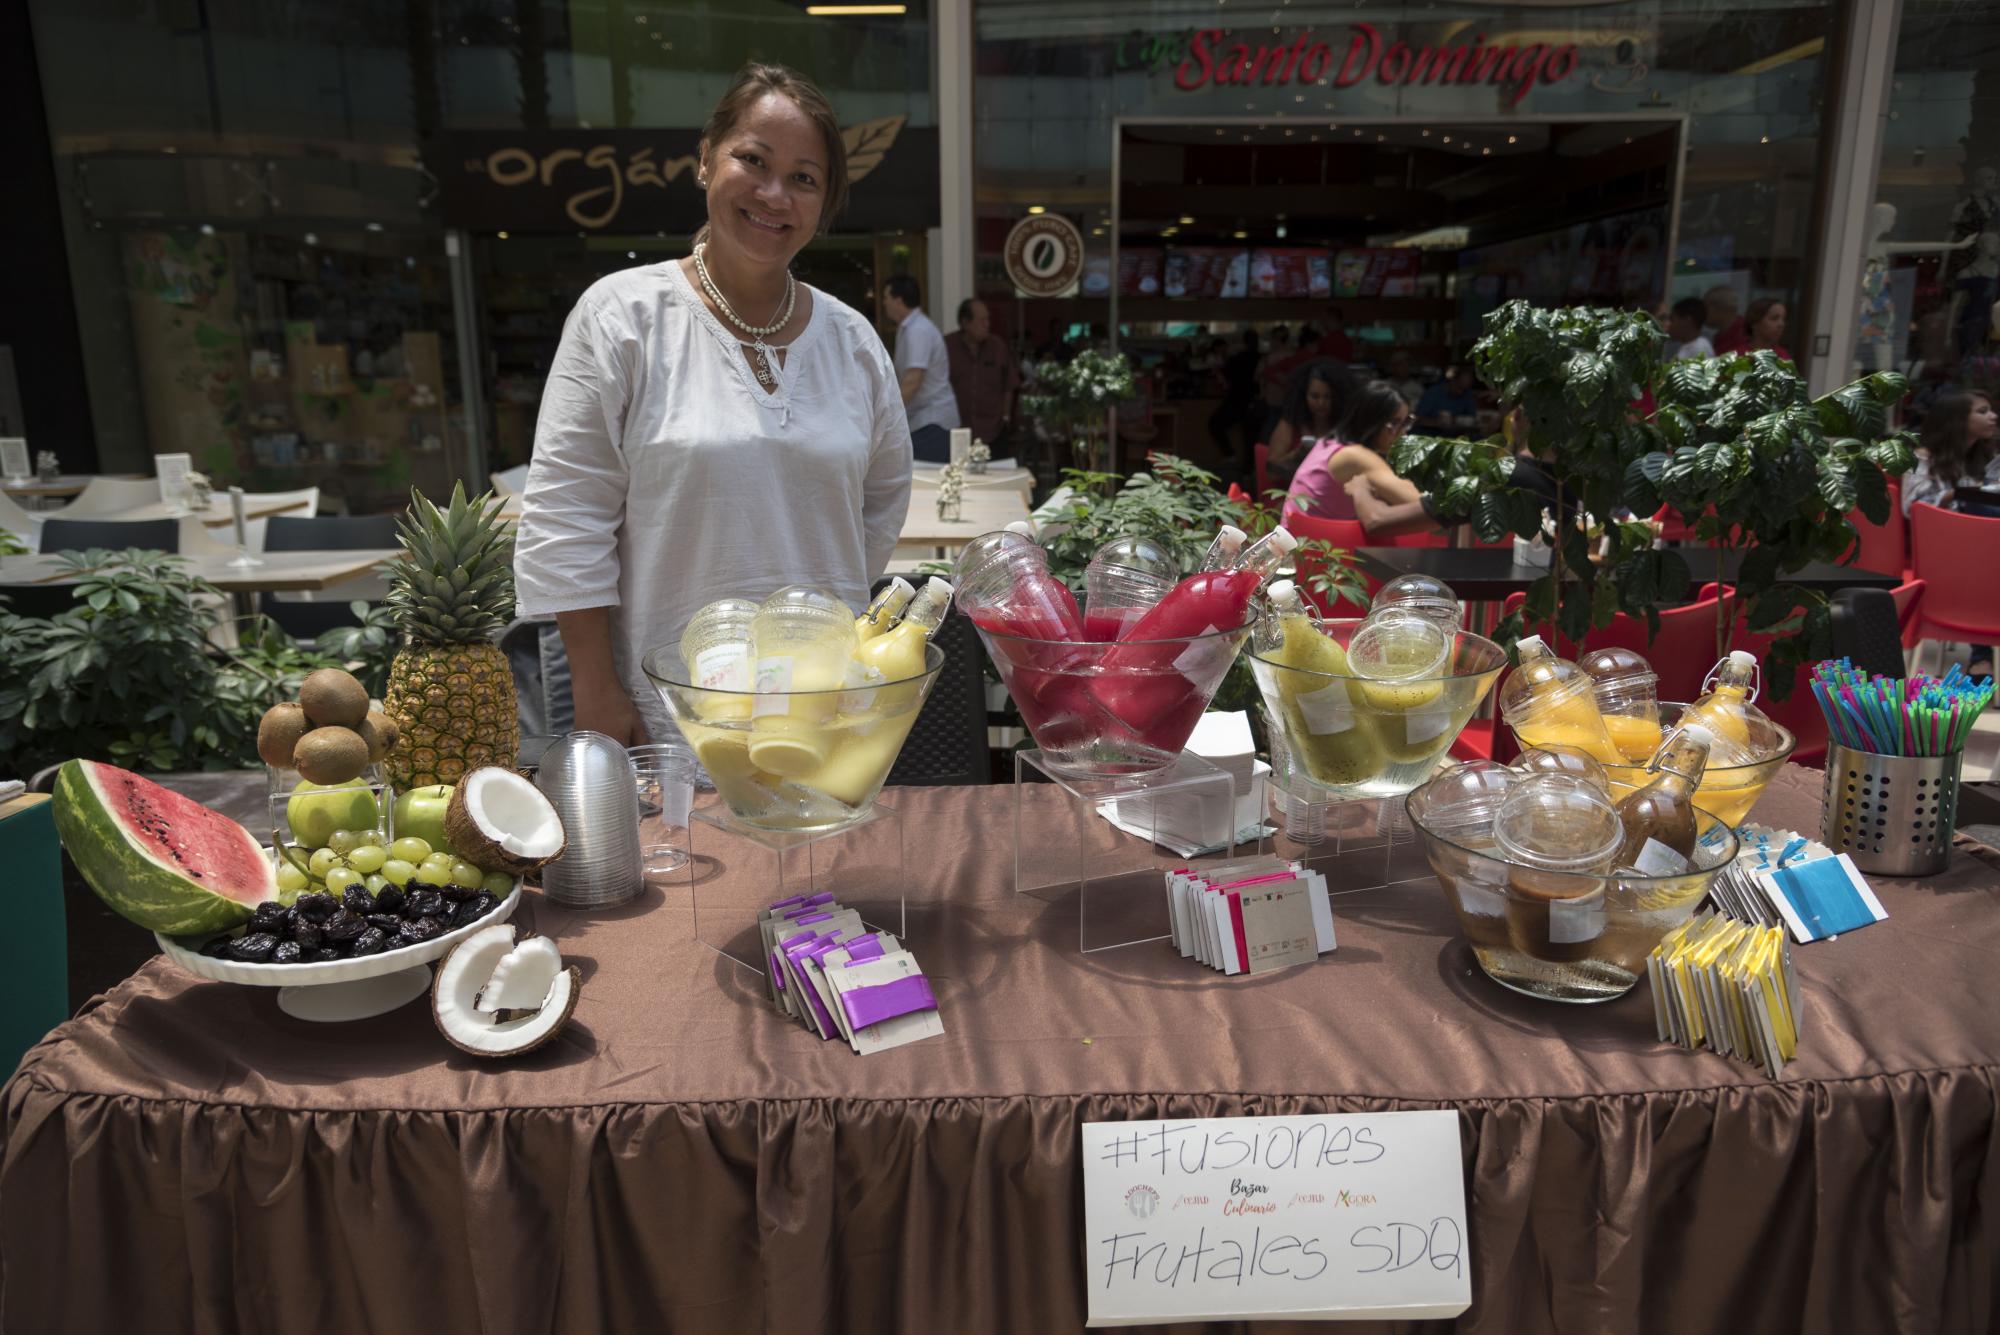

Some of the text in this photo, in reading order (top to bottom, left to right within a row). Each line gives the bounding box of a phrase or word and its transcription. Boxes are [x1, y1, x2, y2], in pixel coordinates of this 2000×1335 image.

[1175, 29, 1332, 90] Santo
[1333, 24, 1580, 108] Domingo
[488, 147, 699, 228] orgán
[1101, 1122, 1385, 1175] #Fusiones
[1223, 1195, 1276, 1217] Culinario
[1230, 1178, 1269, 1197] Bazar
[1102, 1216, 1462, 1288] Frutales SDQ
